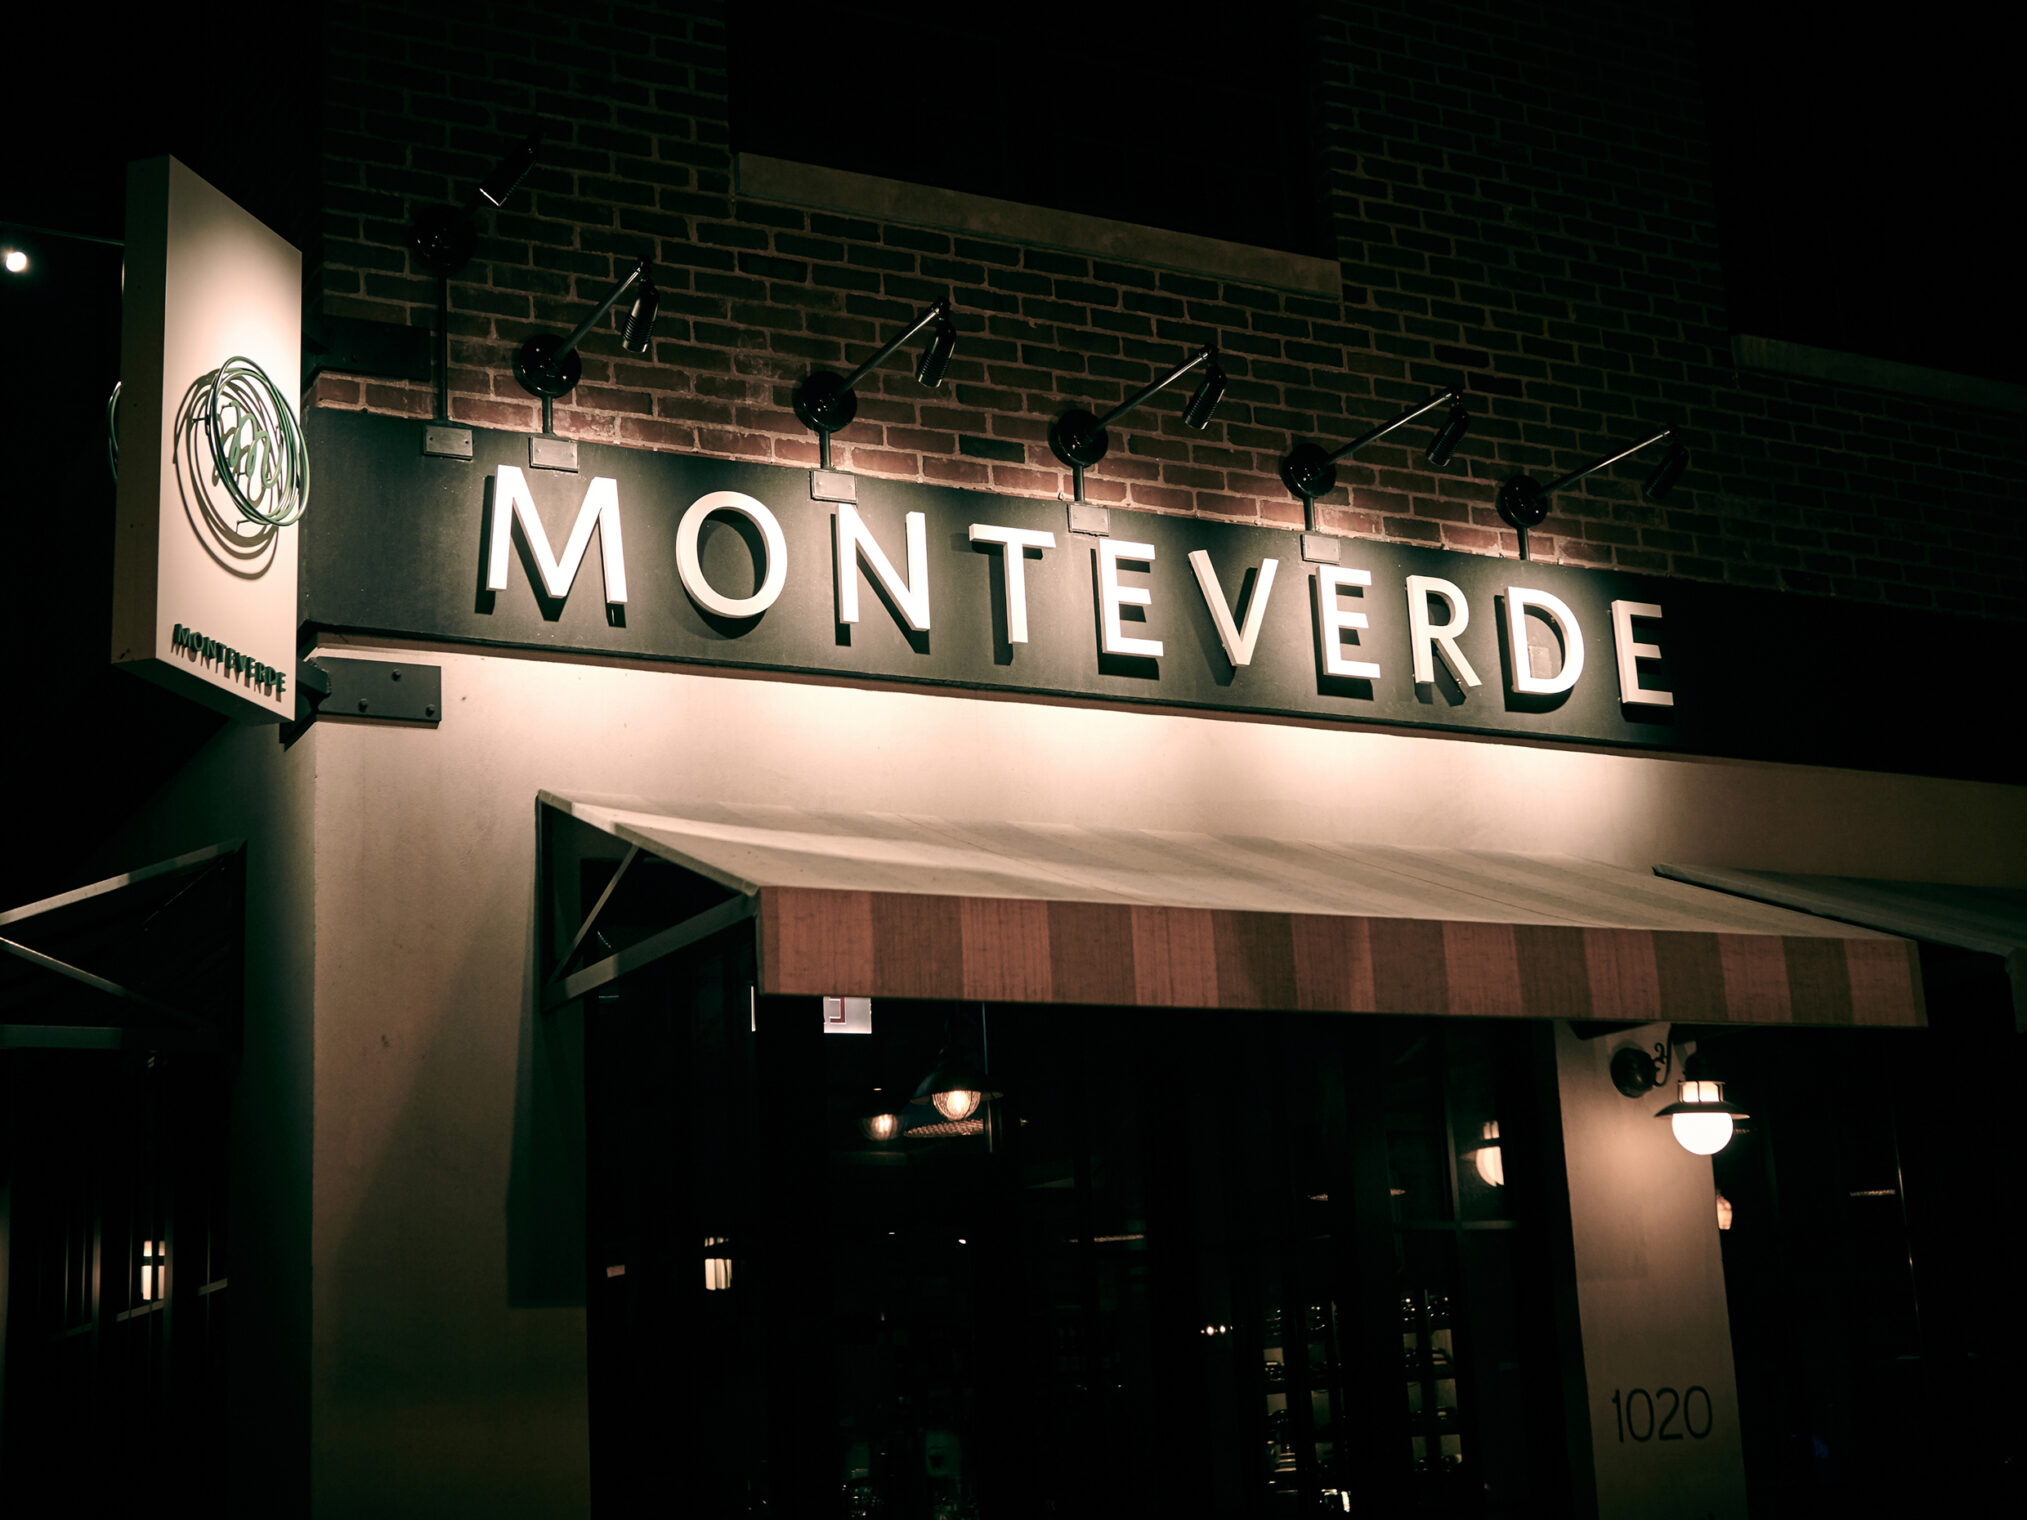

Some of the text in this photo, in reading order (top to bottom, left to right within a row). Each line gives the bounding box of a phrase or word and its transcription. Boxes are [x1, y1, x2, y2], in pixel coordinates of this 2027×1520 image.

[486, 464, 1675, 707] MONTEVERDE
[172, 623, 287, 692] MONTEVERDE
[1612, 1386, 1712, 1442] 1020
